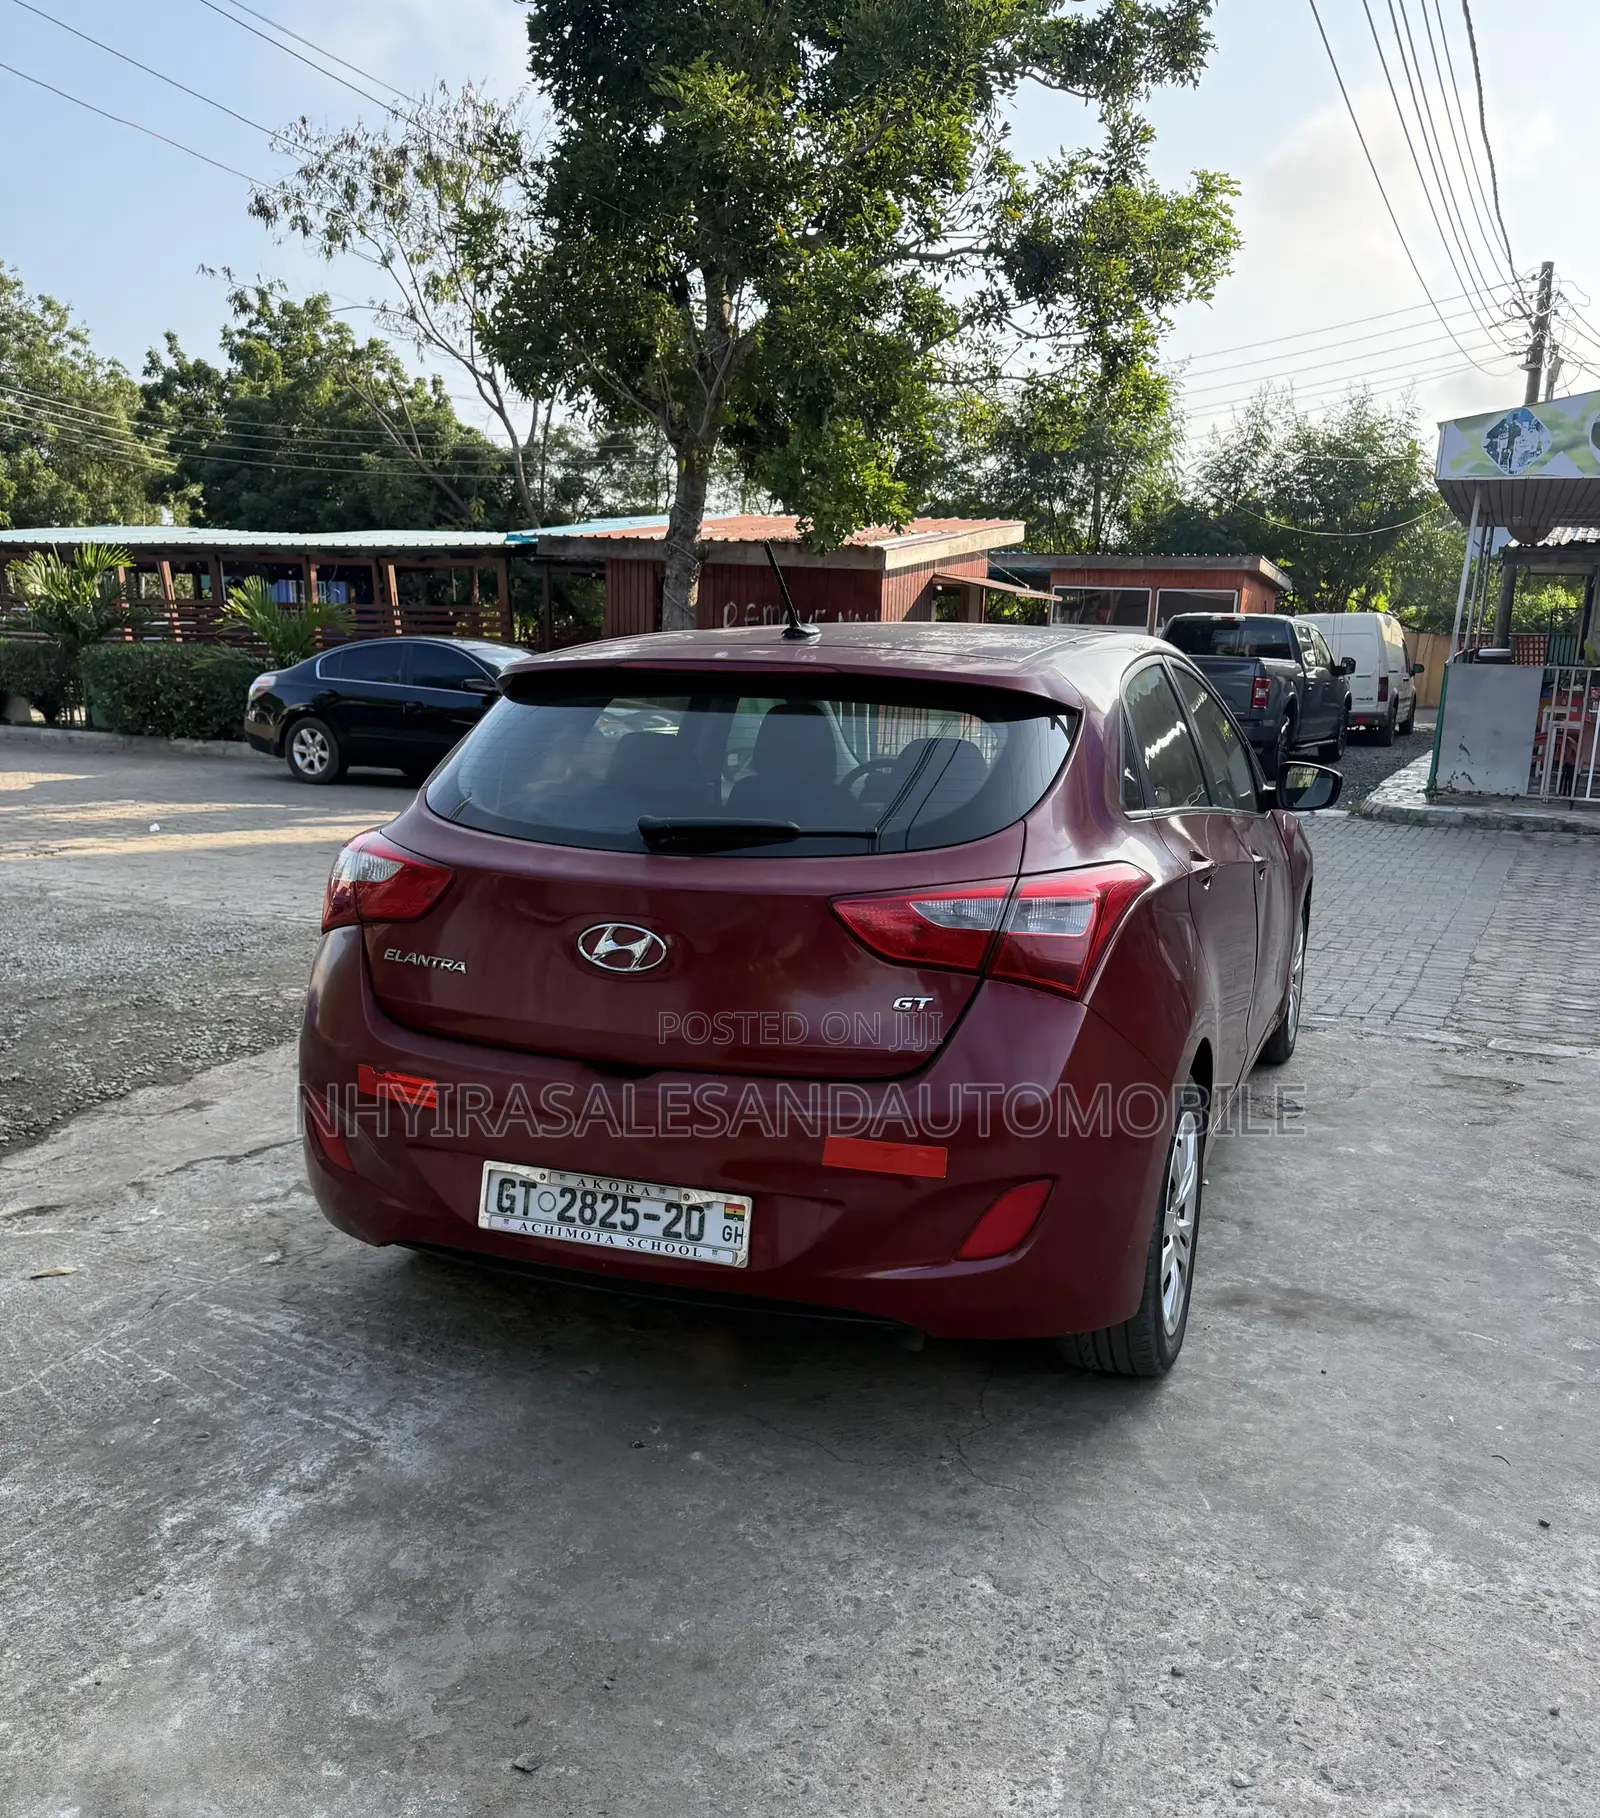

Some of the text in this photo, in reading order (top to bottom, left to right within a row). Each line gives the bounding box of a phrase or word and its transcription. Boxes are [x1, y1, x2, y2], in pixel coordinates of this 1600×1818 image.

[383, 948, 467, 975] ELANTRA
[892, 996, 934, 1012] GT
[576, 1177, 651, 1197] AKORA
[496, 1178, 744, 1245] GT 2825-20 GH
[518, 1221, 702, 1258] ACHIMOTA SCHOOL
